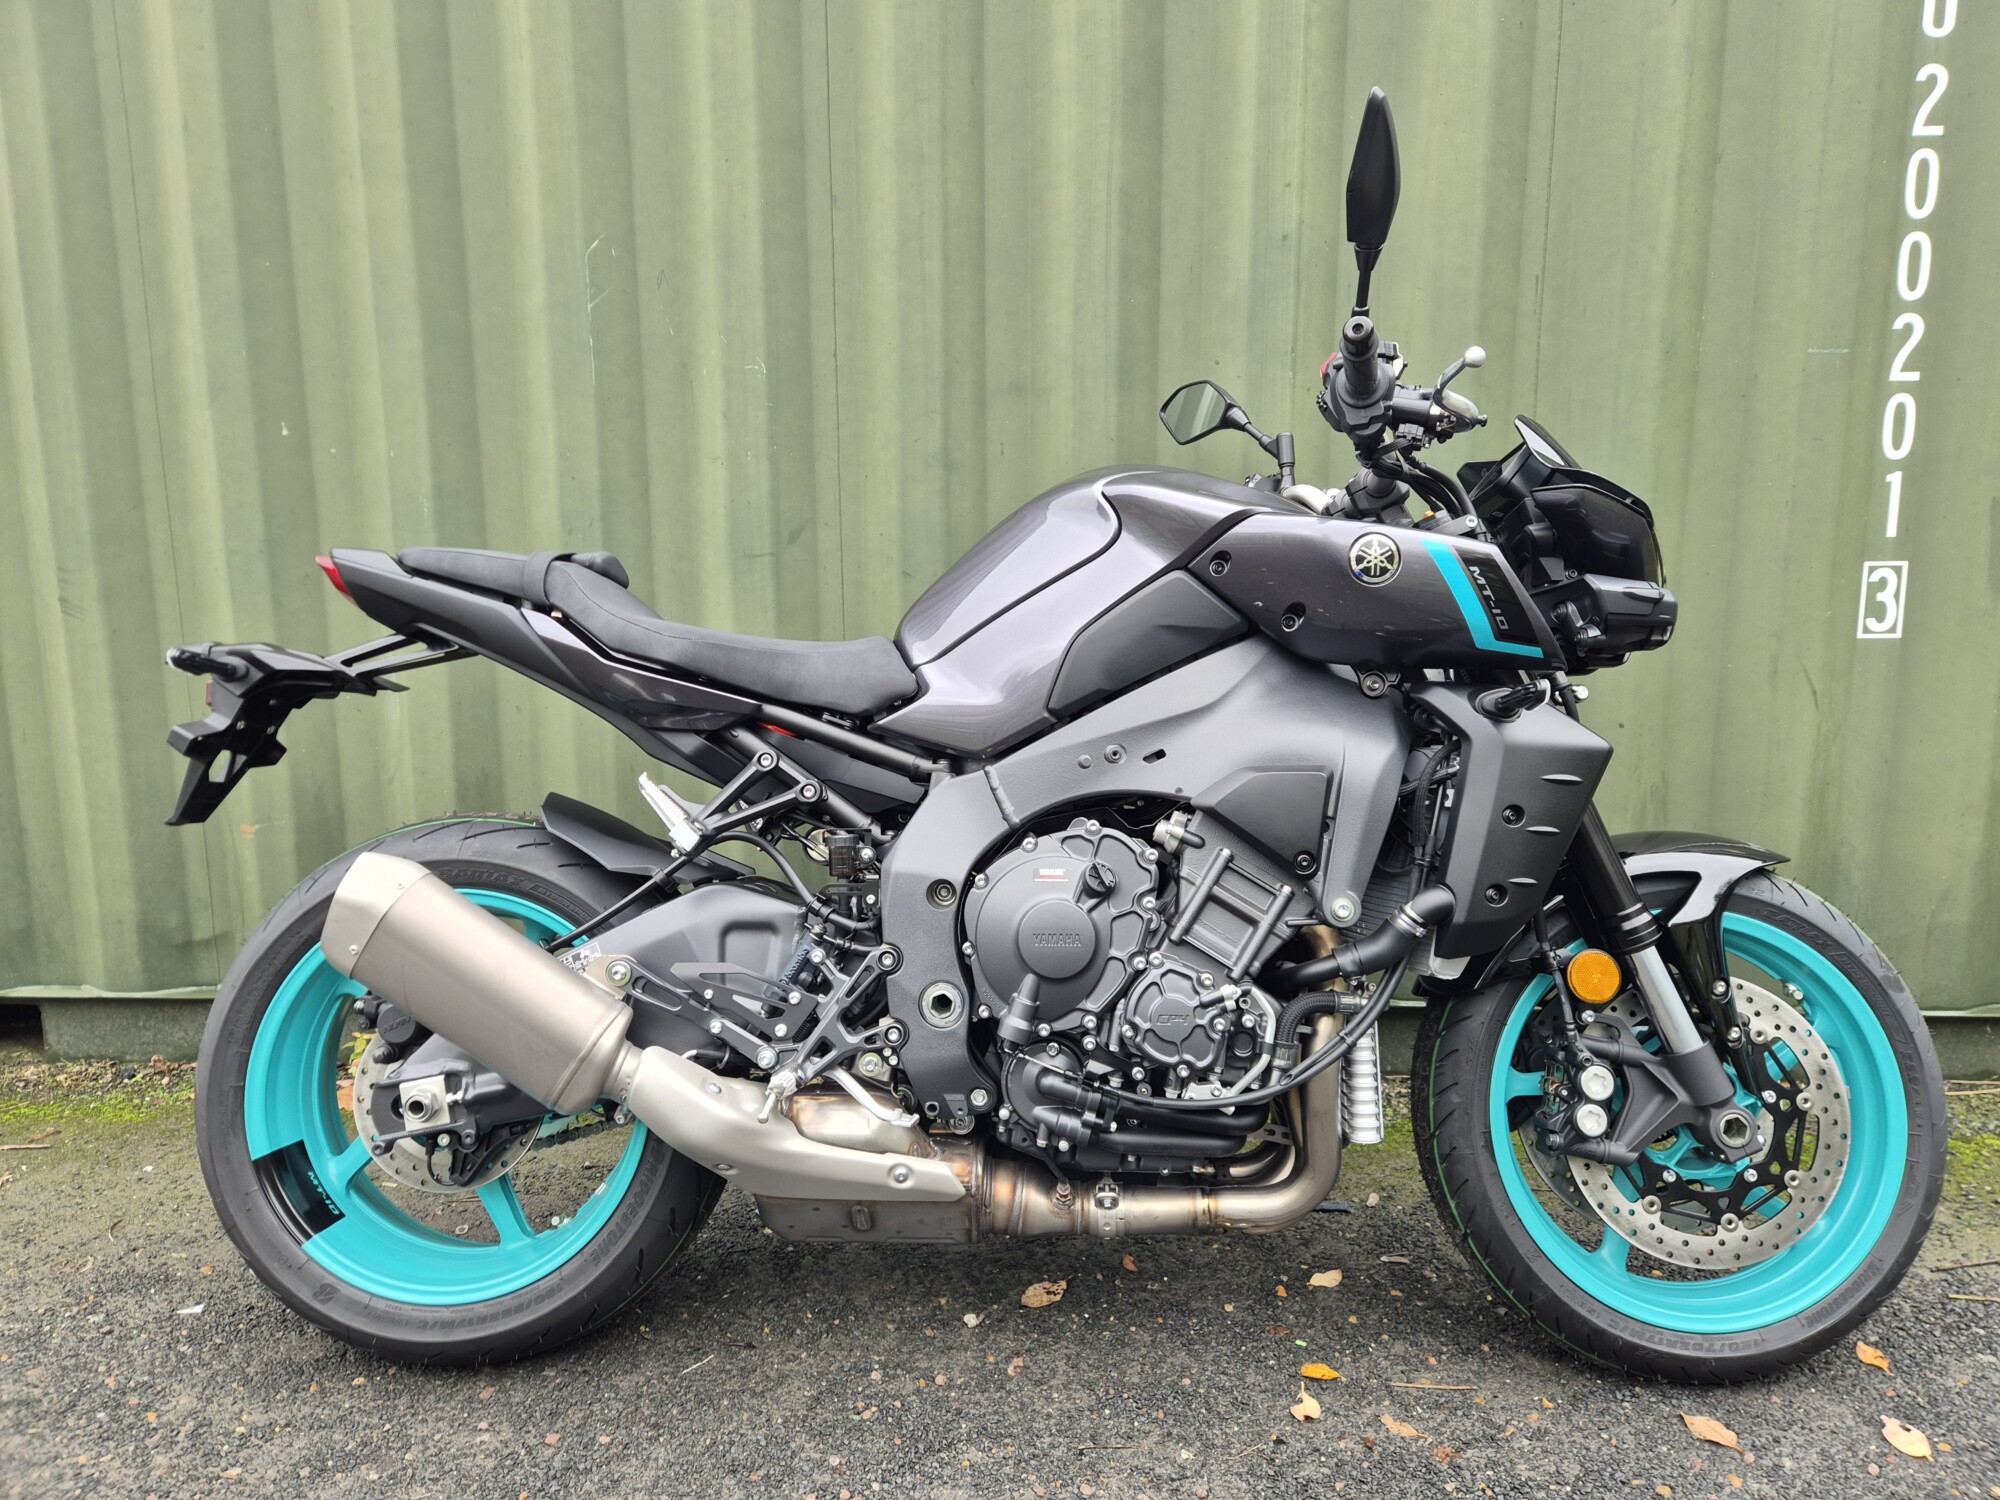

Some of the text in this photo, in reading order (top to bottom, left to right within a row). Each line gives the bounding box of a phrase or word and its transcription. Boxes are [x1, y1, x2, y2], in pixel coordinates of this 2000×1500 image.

[1469, 566, 1509, 630] MT-10
[1865, 567, 1898, 632] 3
[1033, 932, 1082, 947] YAMAHA
[1157, 1013, 1189, 1026] CP4
[308, 1171, 340, 1215] MT-10
[585, 1144, 666, 1266] BRIDGESTONE
